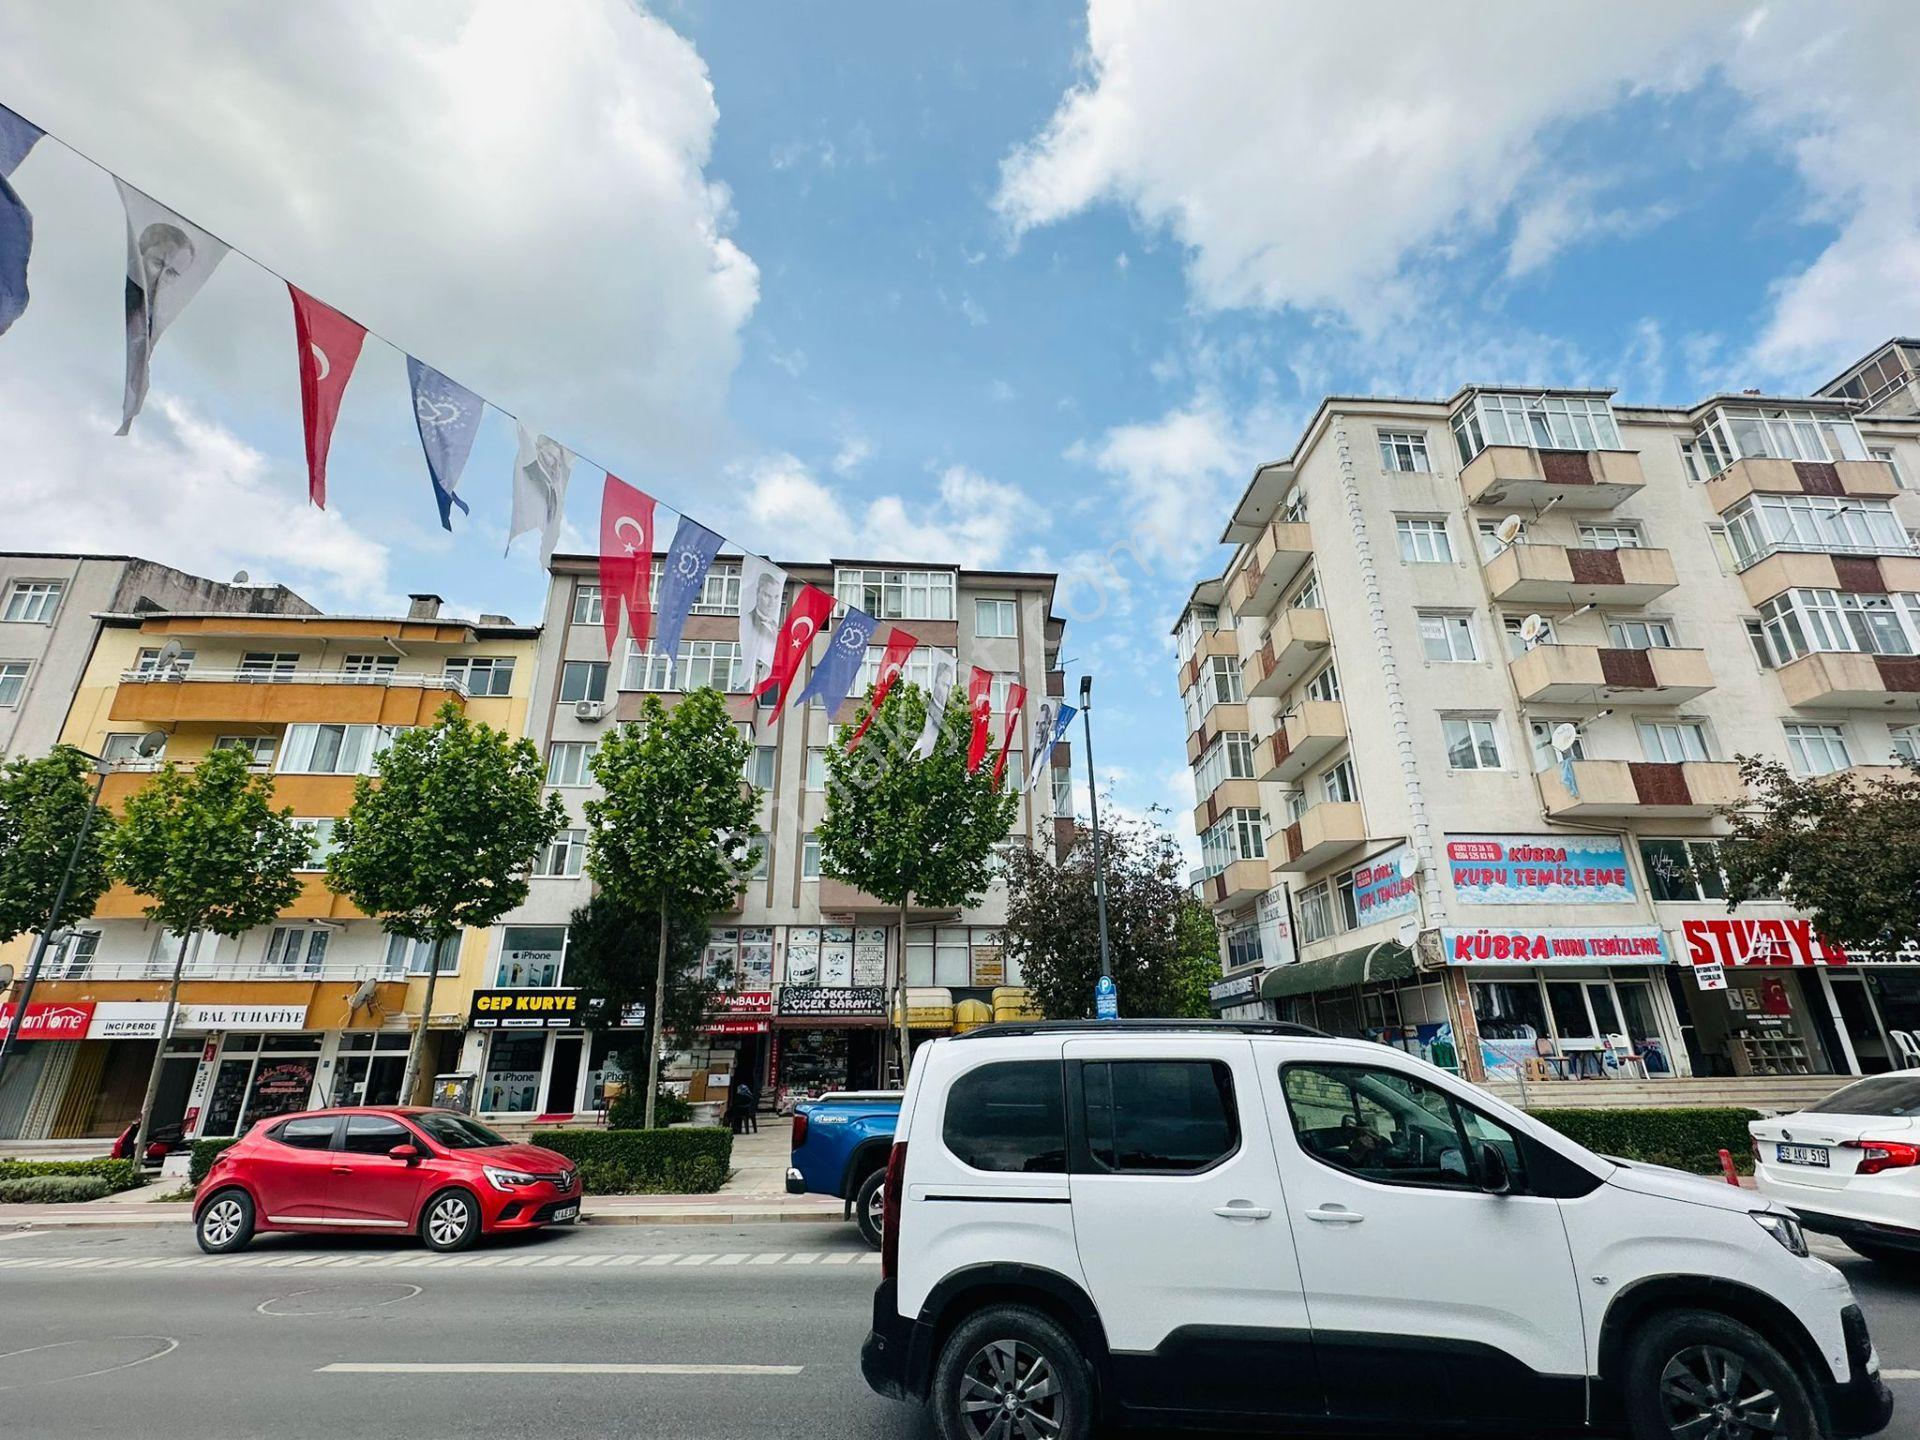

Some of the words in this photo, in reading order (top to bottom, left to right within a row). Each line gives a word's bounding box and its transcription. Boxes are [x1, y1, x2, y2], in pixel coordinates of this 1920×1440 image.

[1508, 844, 1567, 863] KÜBRA
[1453, 869, 1507, 887] KURU
[1513, 864, 1626, 887] TEMİZLEME
[1455, 929, 1550, 961] KÜBRA
[1551, 939, 1588, 956] KURU
[1589, 936, 1662, 955] TEMİZLEME
[521, 952, 551, 960] iPhone
[725, 996, 770, 1005] AMBALAJ
[813, 989, 852, 1000] GÖKÇE
[477, 996, 512, 1011] CEP
[516, 997, 577, 1010] KURYE
[199, 1012, 226, 1022] BAL
[231, 1009, 303, 1023] TUHAFİYE
[126, 1022, 157, 1030] PERDE
[503, 1073, 534, 1081] iPhone
[1781, 1147, 1790, 1158] 59
[1794, 1148, 1807, 1160] AKU
[1811, 1150, 1826, 1162] 519
